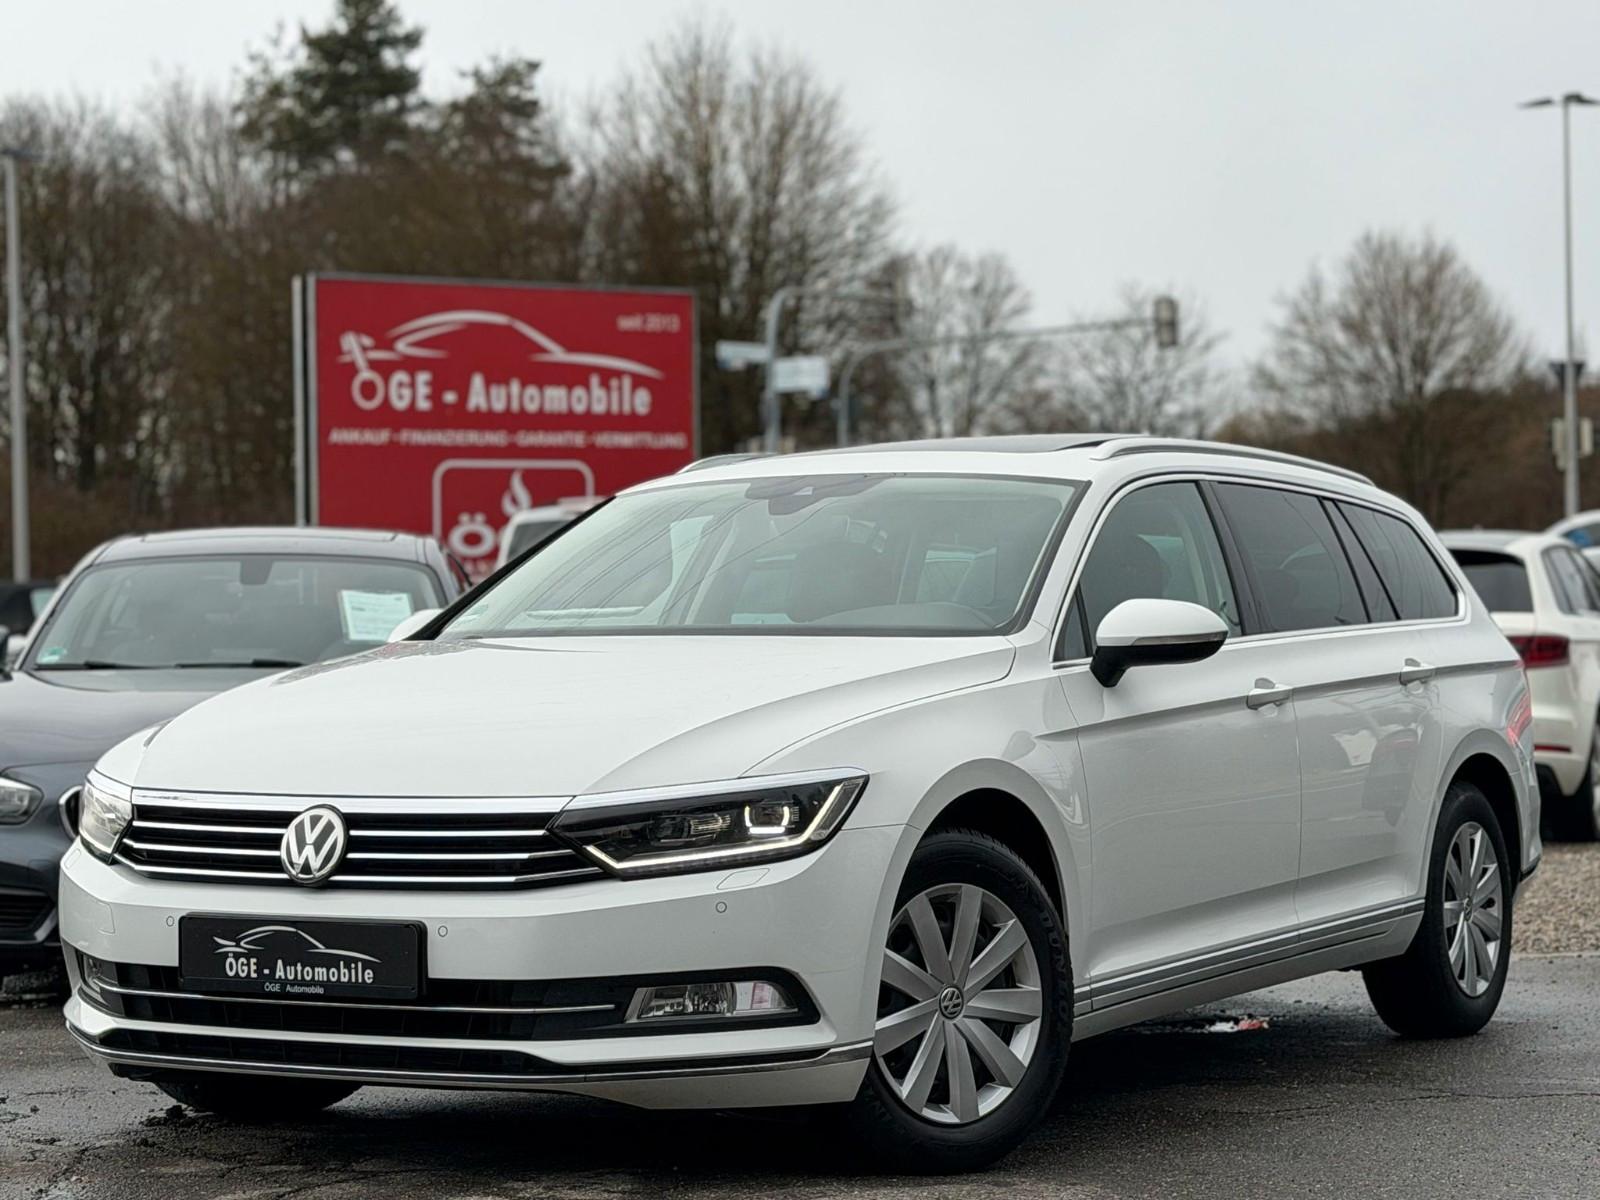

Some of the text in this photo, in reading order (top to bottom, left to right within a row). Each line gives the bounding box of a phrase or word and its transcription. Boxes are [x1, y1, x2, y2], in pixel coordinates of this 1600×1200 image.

[466, 371, 652, 415] Automobile
[225, 952, 258, 978] ÖGE
[275, 959, 374, 984] Automobile
[264, 981, 325, 995] ÖGE Automobile
